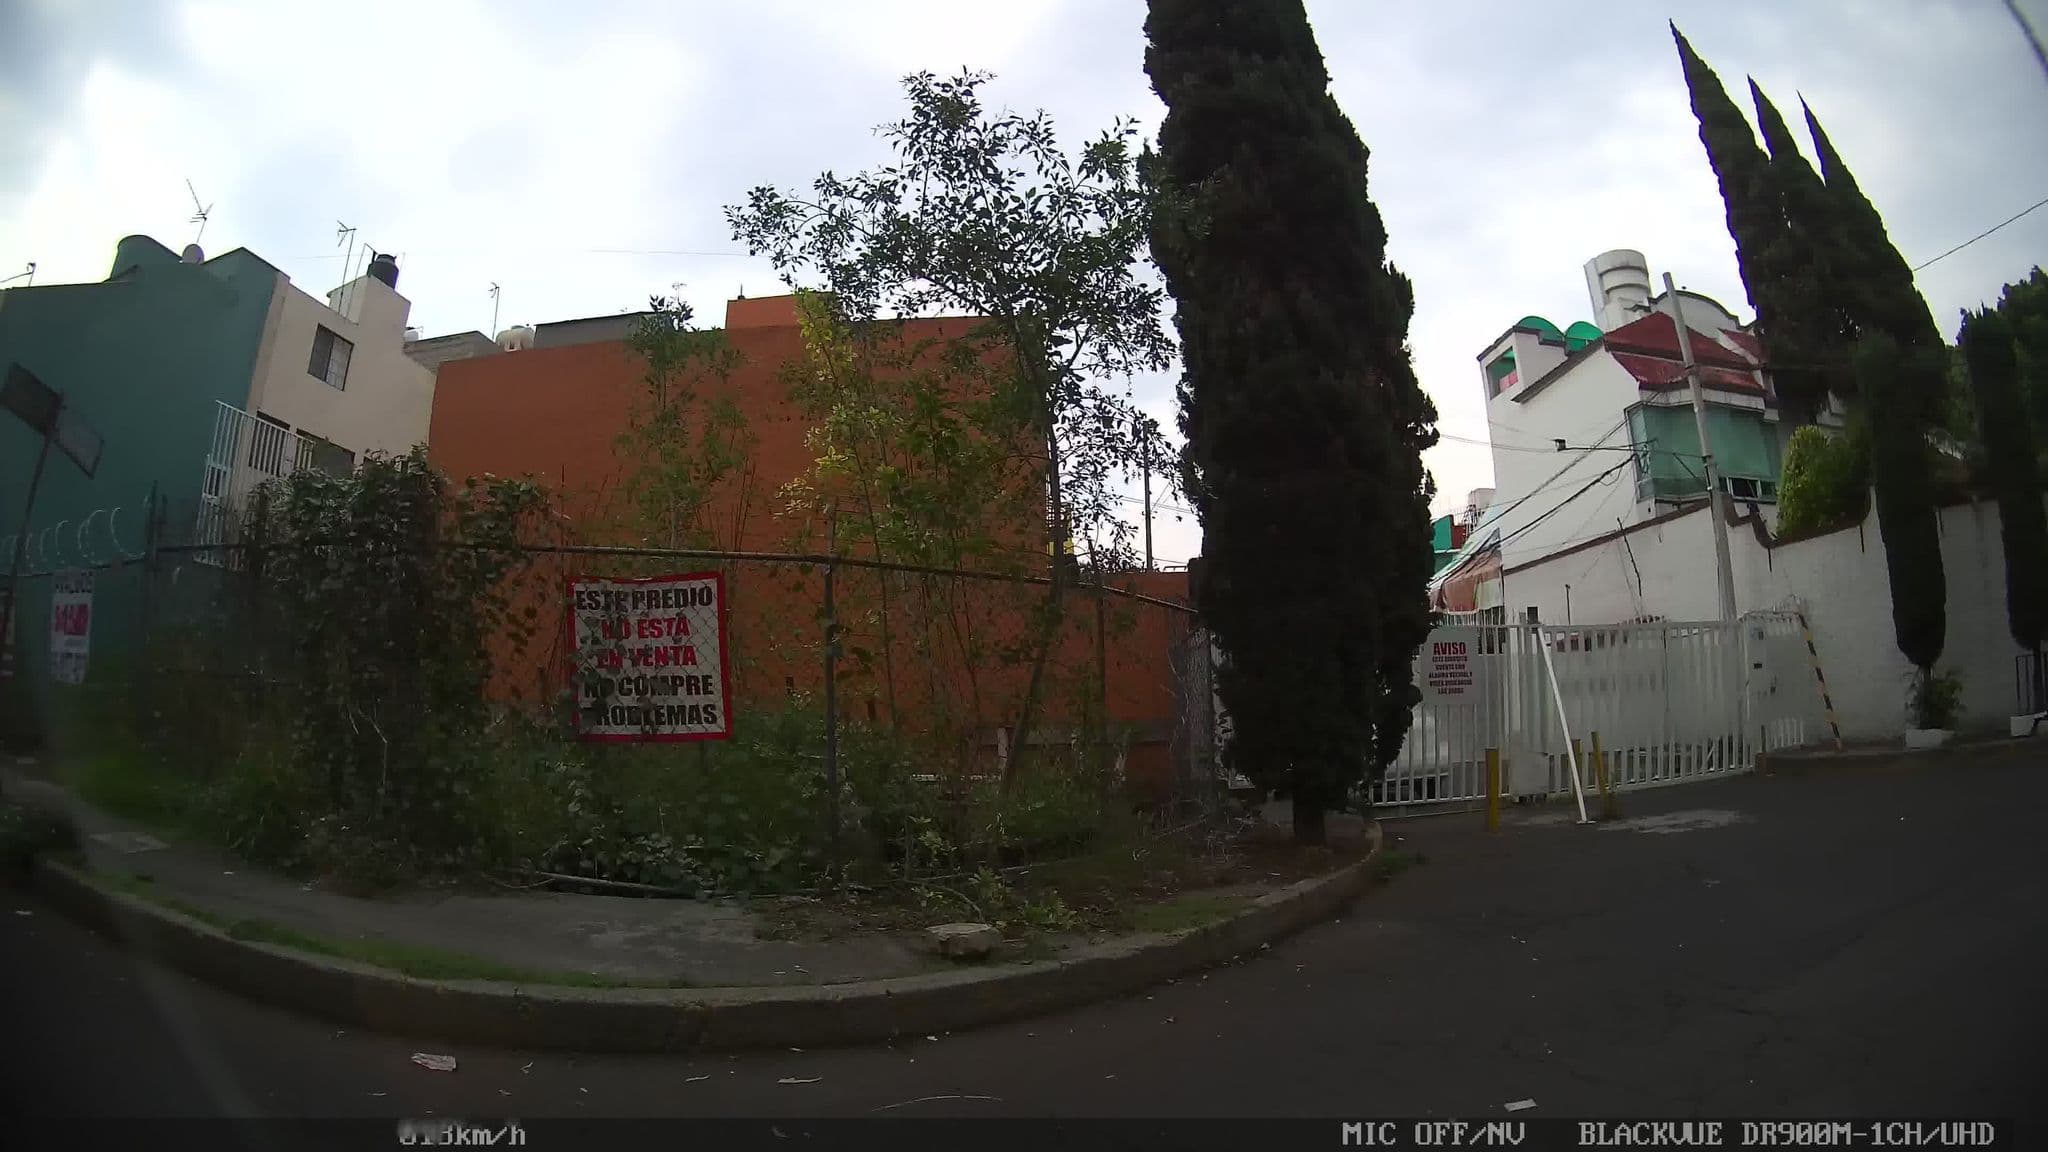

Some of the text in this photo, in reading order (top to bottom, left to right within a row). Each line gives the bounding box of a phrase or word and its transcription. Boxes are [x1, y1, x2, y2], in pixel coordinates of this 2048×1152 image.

[632, 586, 713, 610] PREDIO
[601, 617, 631, 640] NO
[630, 645, 698, 667] VENTA
[1433, 642, 1466, 655] AVISO
[584, 676, 614, 698] N
[583, 703, 718, 726] ROBLEMAS
